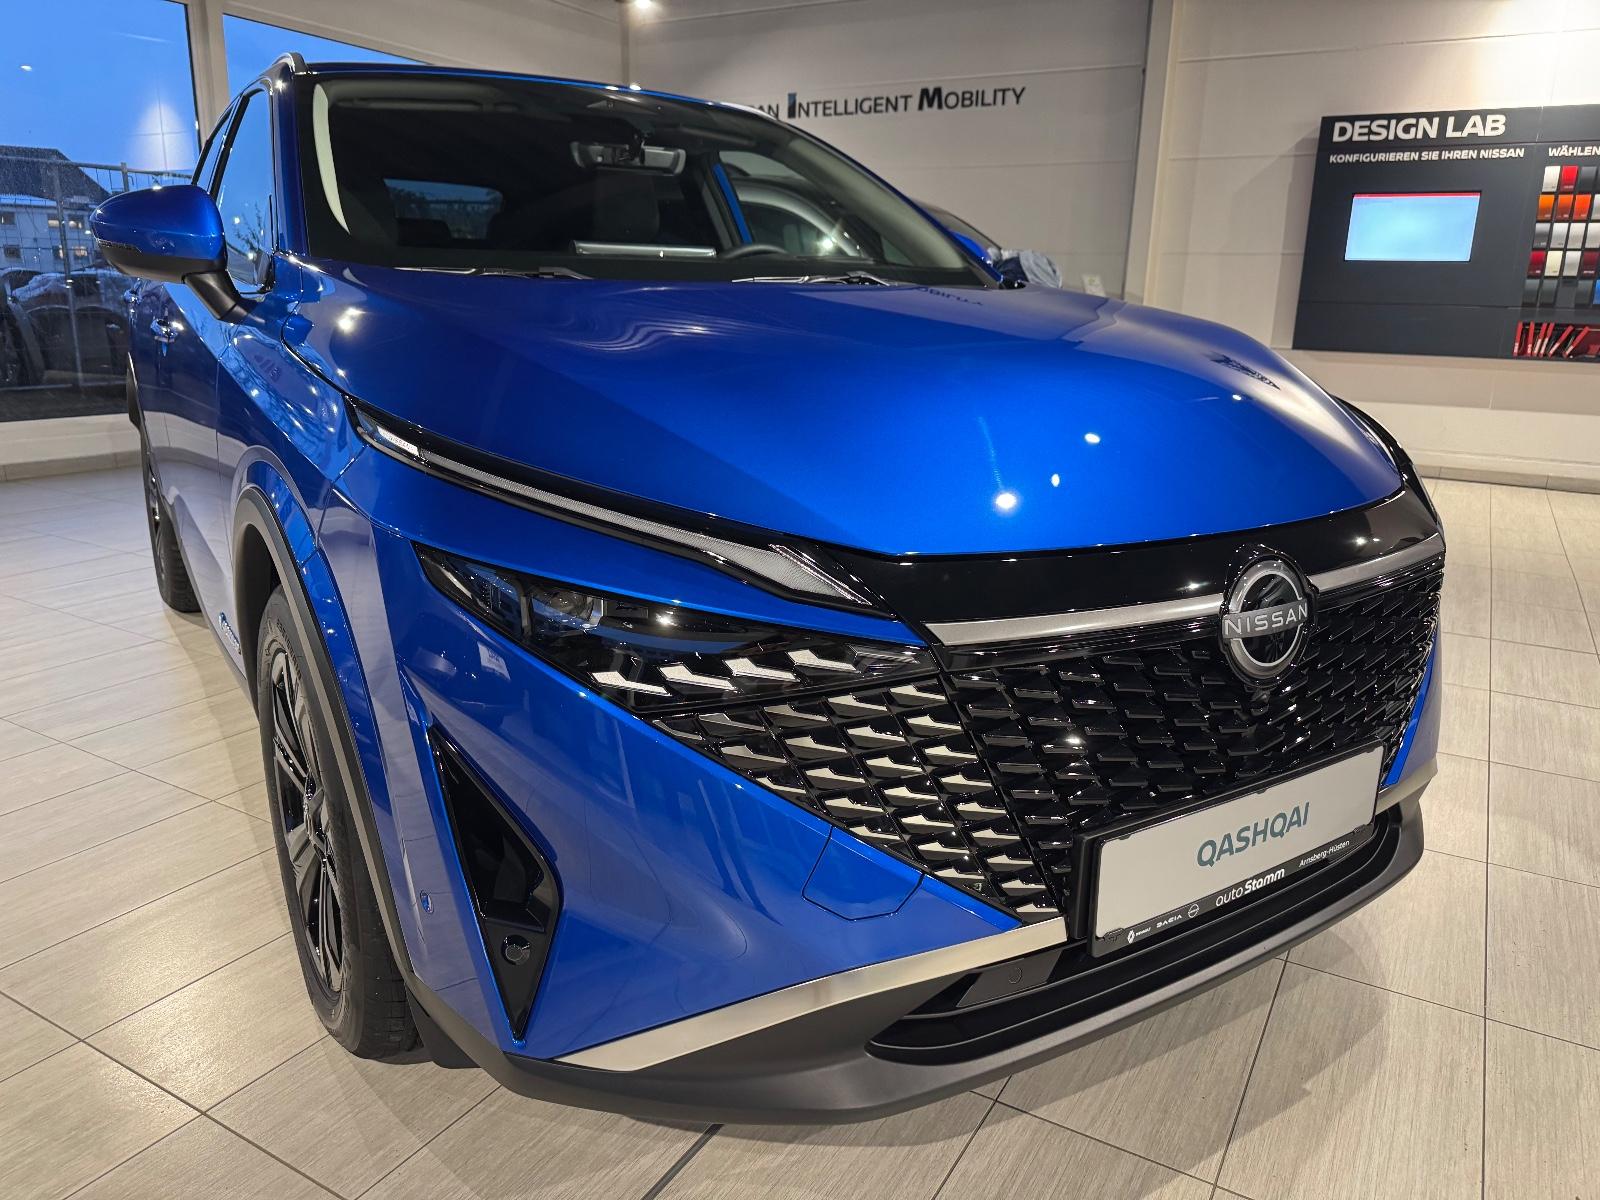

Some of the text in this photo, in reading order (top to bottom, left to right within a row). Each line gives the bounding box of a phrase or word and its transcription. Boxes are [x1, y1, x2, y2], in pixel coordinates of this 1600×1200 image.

[787, 92, 913, 119] INTELLIGENT
[918, 86, 1026, 111] MOBILITY
[1332, 114, 1506, 142] DESIGN LAB
[1329, 147, 1525, 164] KONFIGURIEREN SIE IHREN NISSAN
[1224, 602, 1308, 636] NISSAN
[1197, 802, 1310, 867] QASHQAI
